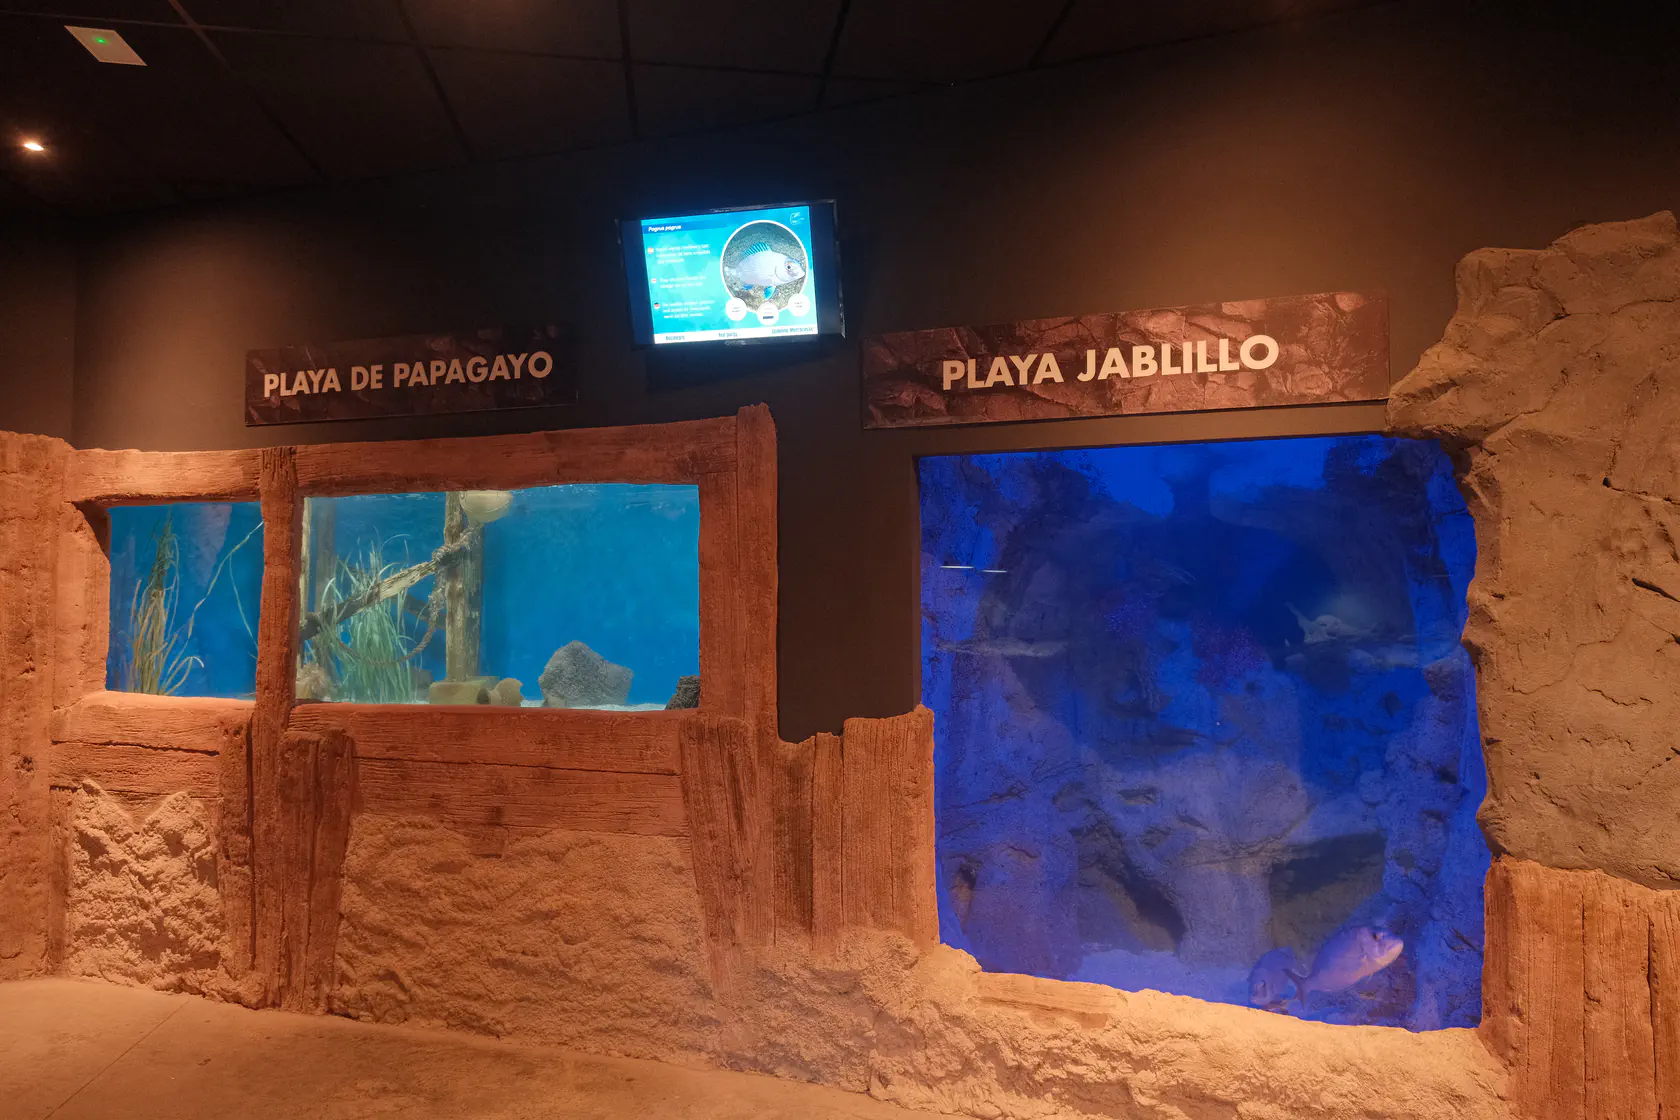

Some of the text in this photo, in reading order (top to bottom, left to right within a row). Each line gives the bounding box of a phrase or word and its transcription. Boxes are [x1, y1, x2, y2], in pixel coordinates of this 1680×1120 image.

[263, 351, 553, 398] PLAYA DE PAPAGAYO
[942, 334, 1280, 390] PLAYA JABLILLO
